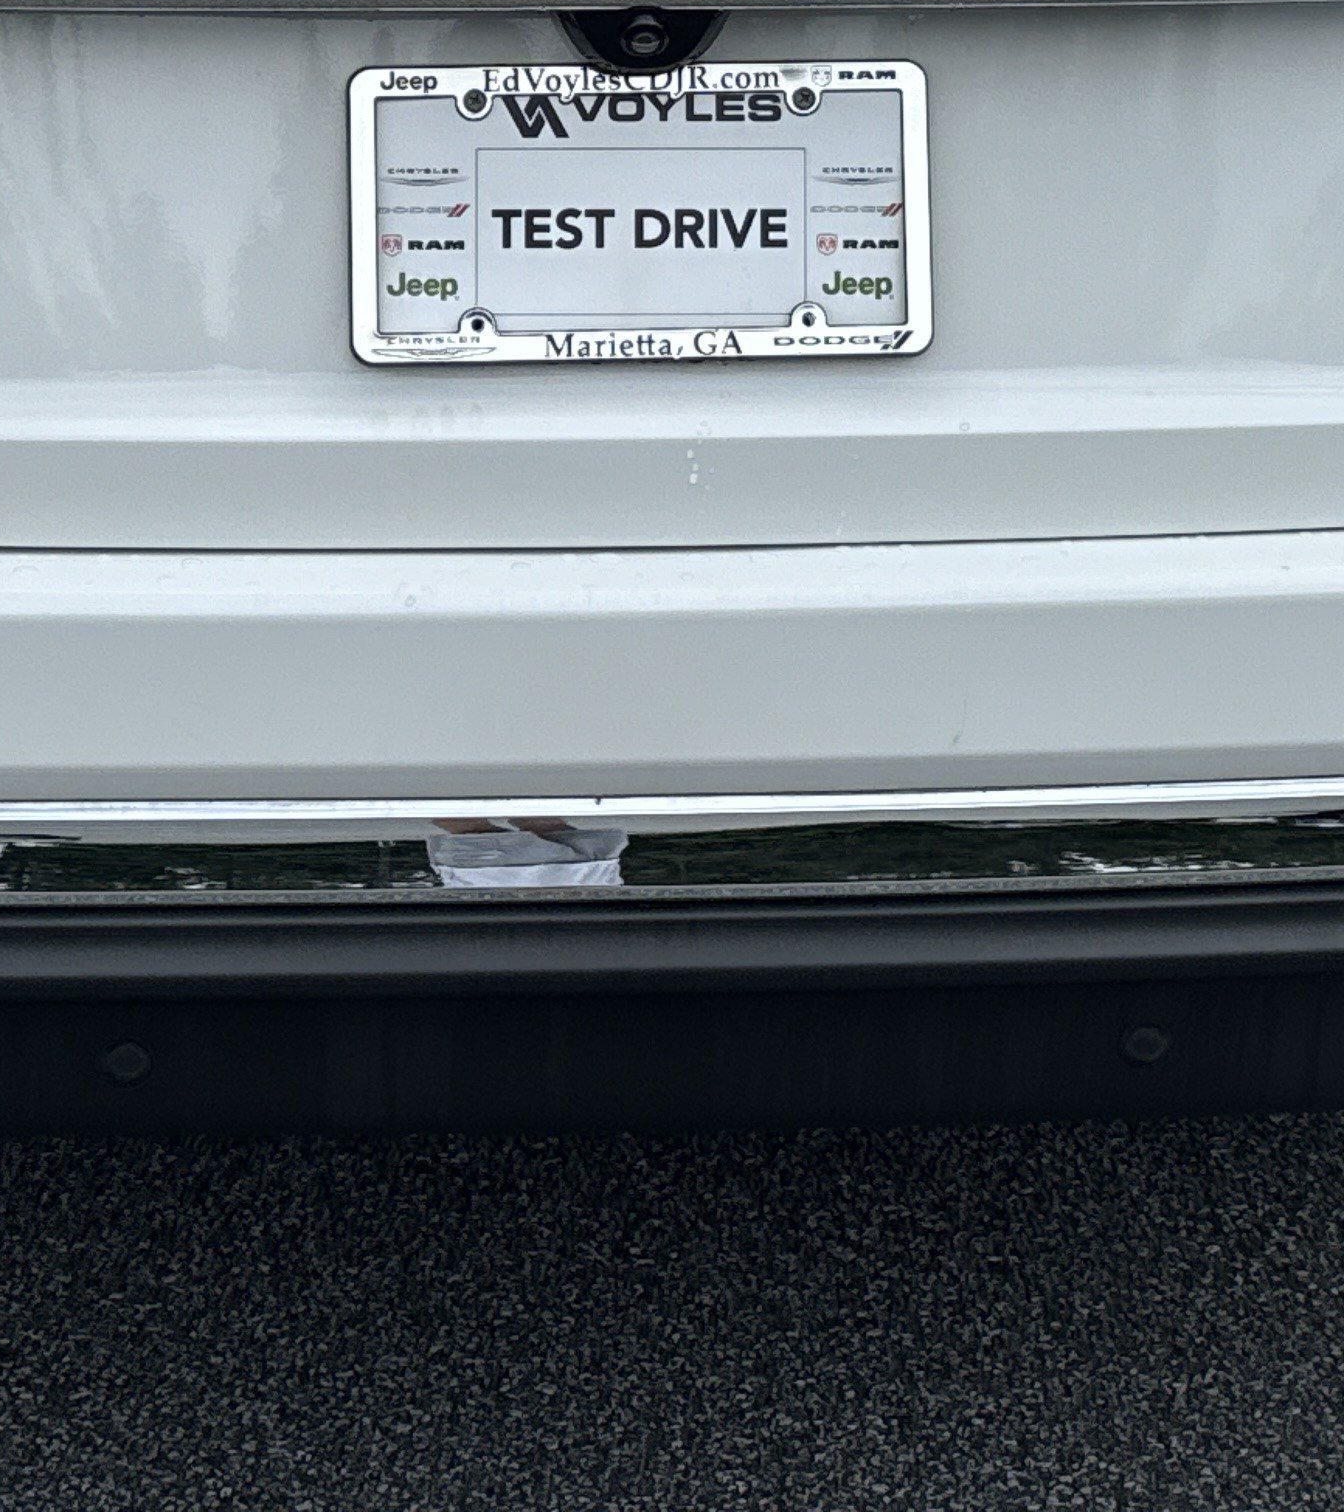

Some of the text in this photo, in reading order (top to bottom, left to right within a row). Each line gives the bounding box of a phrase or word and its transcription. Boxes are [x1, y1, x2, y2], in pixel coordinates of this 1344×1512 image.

[380, 71, 438, 93] Jeep
[482, 67, 780, 100] EdVoylesCDJR.com
[838, 69, 897, 81] RAM
[572, 93, 782, 122] VOYLES
[492, 208, 788, 249] TEST DRIVE
[408, 239, 466, 251] RAM
[842, 239, 900, 250] RAM
[386, 271, 460, 301] Jeep
[821, 270, 894, 300] Jeep
[545, 330, 743, 356] Marietta, GA
[773, 335, 894, 347] DODGE
